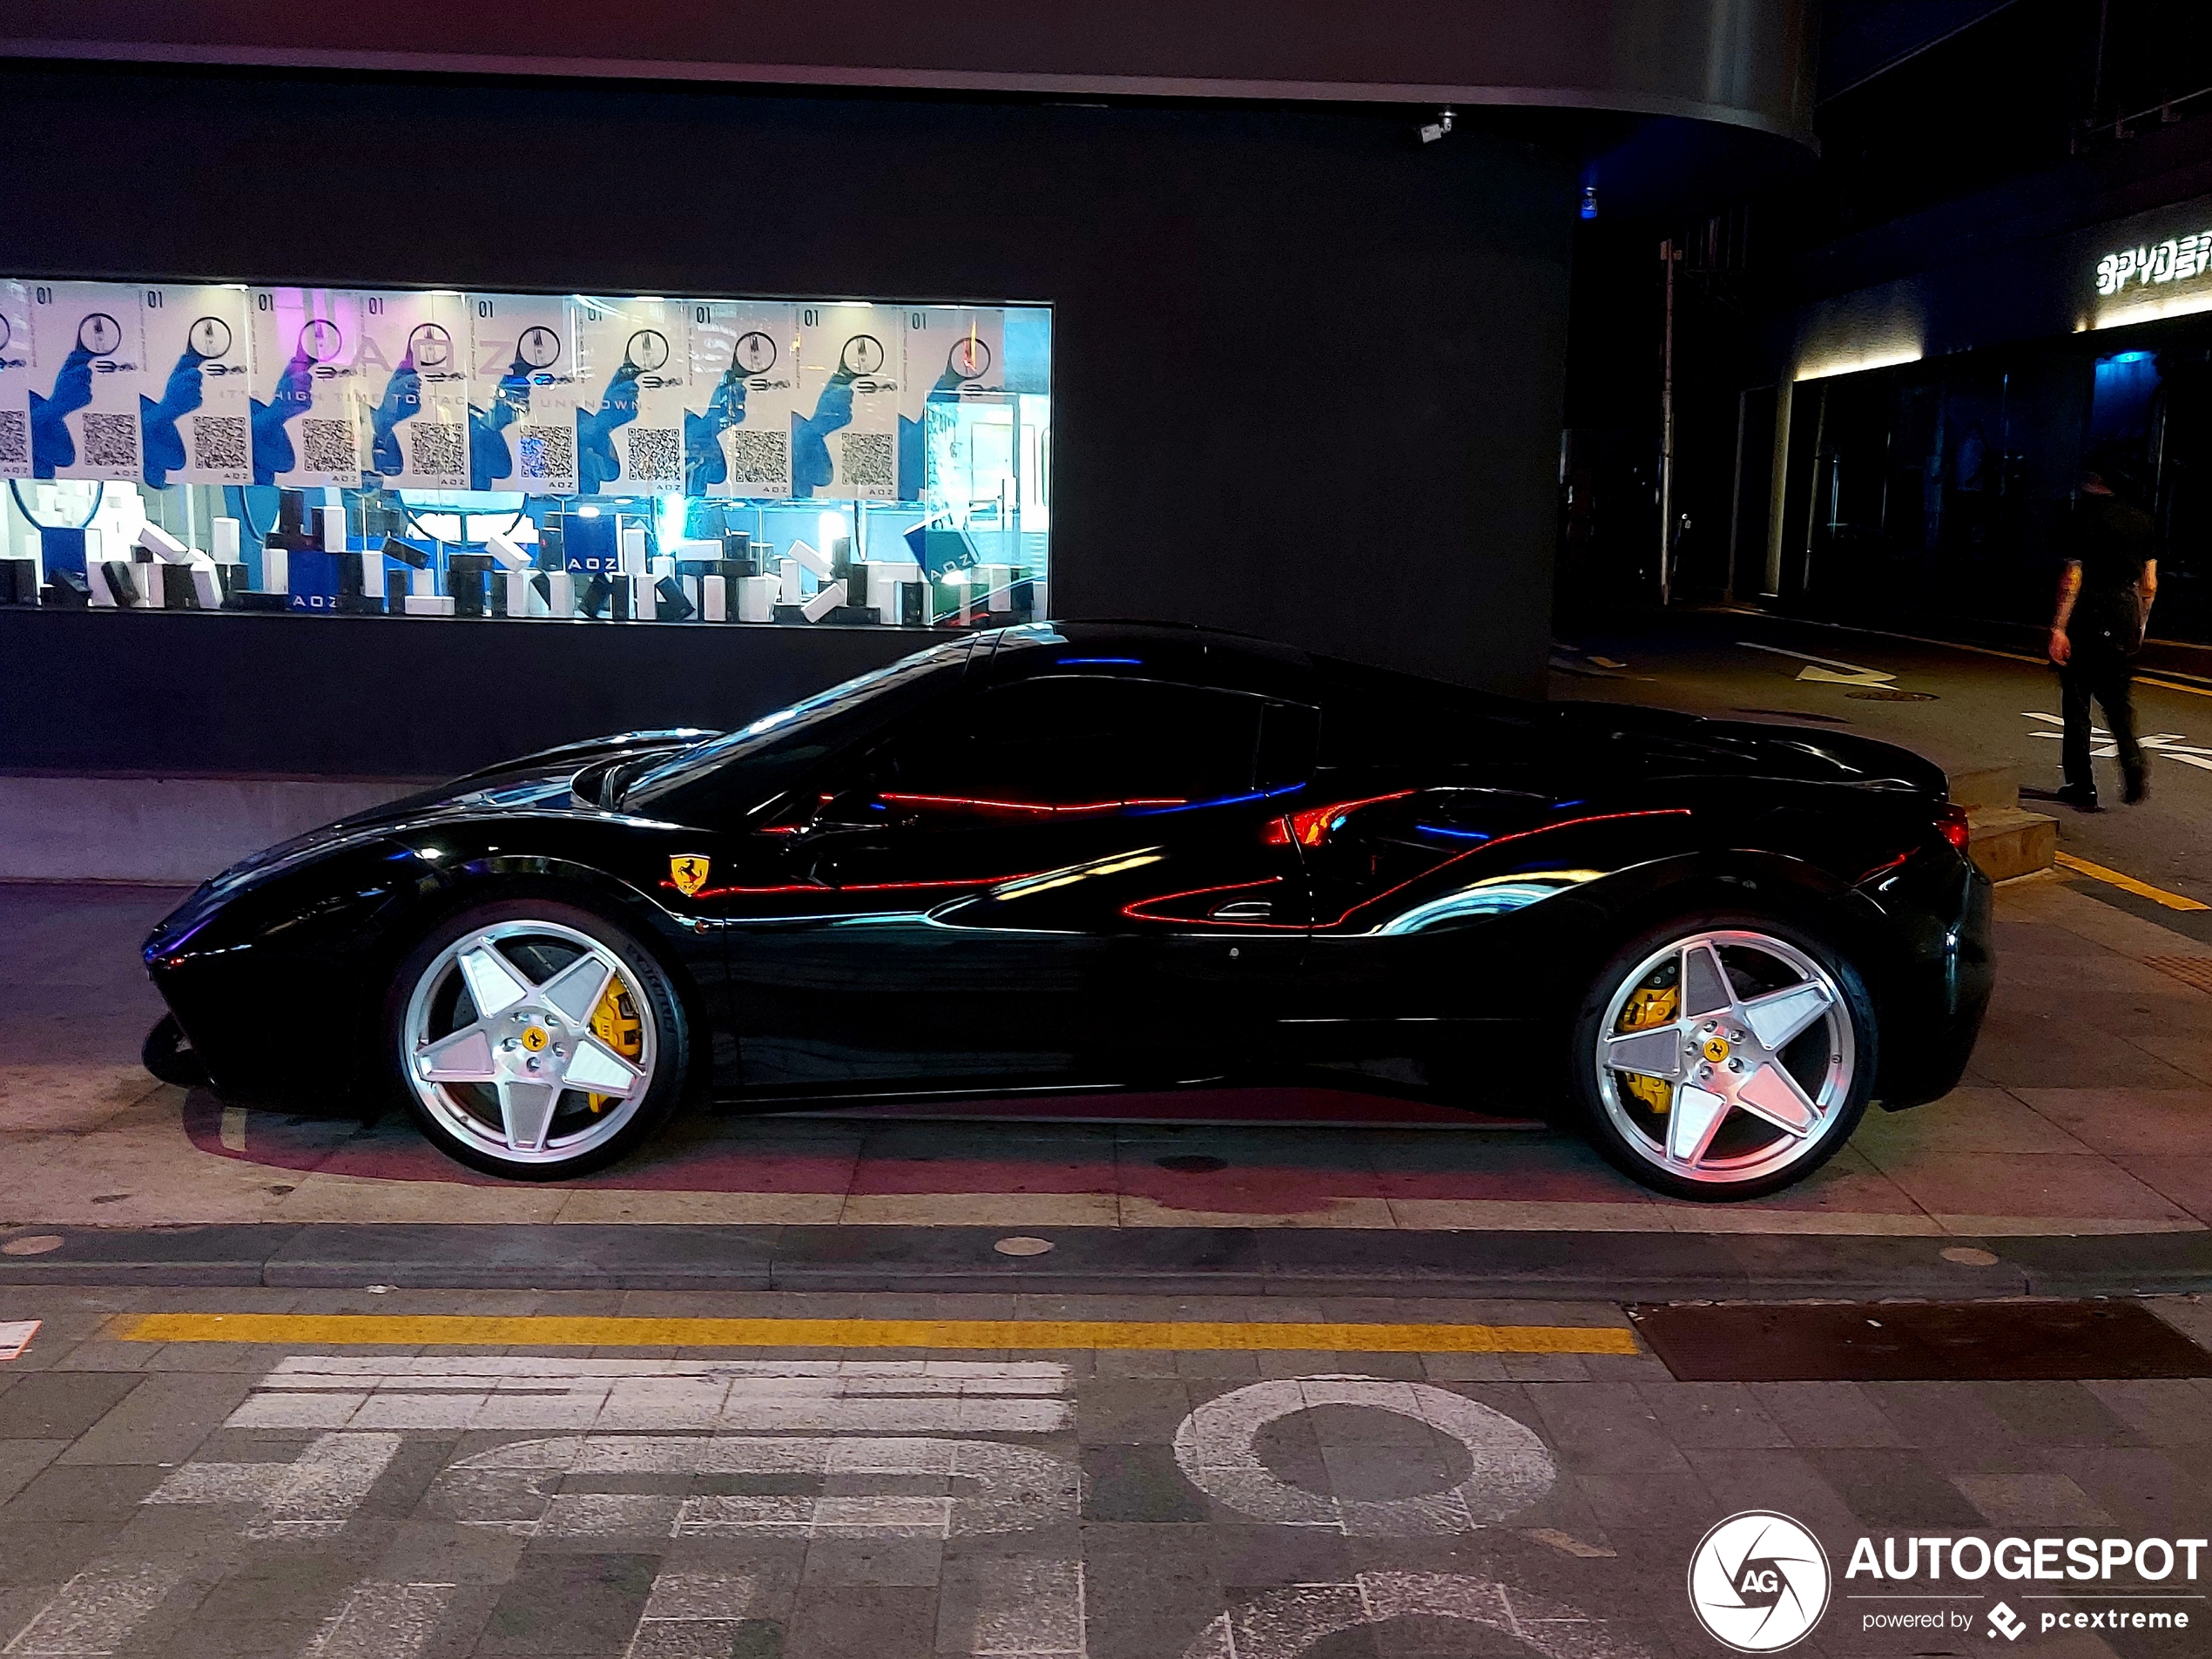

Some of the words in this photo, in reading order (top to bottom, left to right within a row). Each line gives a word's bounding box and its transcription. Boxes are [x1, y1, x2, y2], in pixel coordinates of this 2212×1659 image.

[37, 287, 52, 305] 01
[146, 291, 163, 308] 01
[258, 293, 274, 312] 01
[368, 297, 384, 315] 01
[478, 300, 494, 318] 01
[696, 306, 711, 325] 01
[804, 309, 819, 327] 01
[912, 313, 927, 330] 01
[568, 557, 617, 570] AOZ
[292, 595, 339, 609] AOZ
